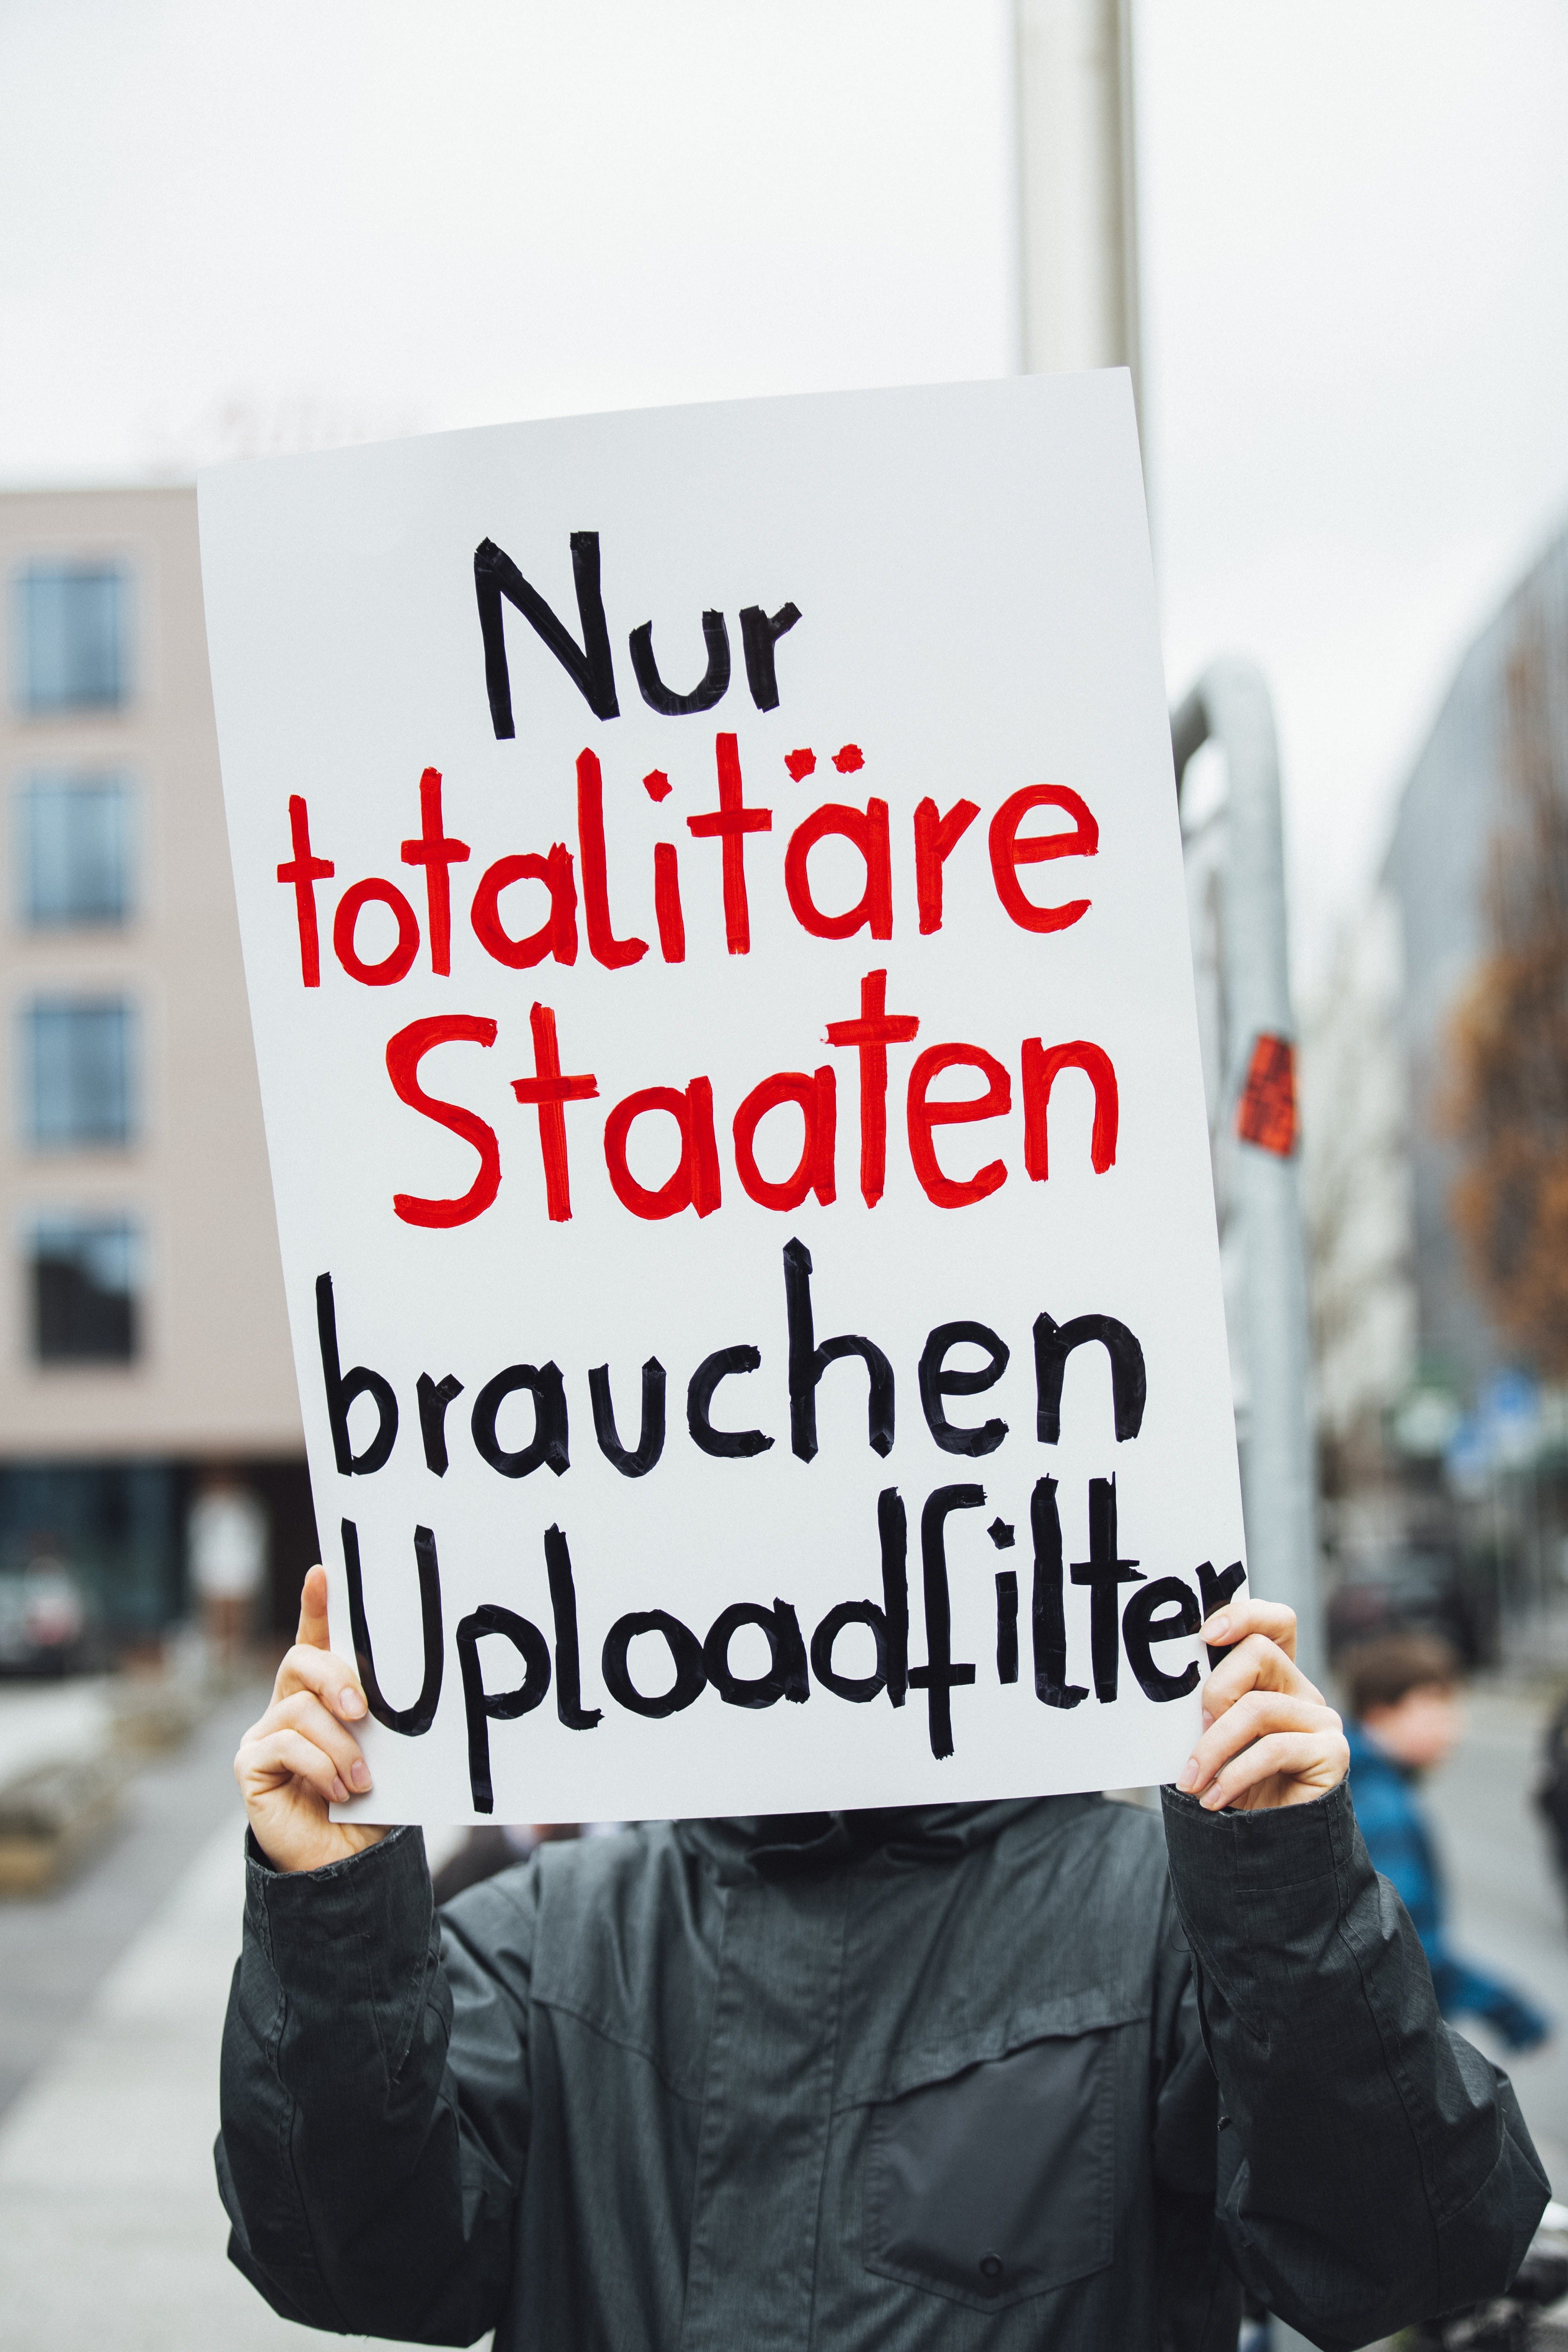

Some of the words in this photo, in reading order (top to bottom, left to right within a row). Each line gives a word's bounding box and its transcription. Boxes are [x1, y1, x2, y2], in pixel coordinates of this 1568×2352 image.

[474, 531, 802, 740] Nur
[277, 733, 1099, 987] totalitäre
[386, 969, 1118, 1228] Staaten
[316, 1237, 1146, 1477] brauchen
[341, 1471, 1246, 1814] Uploadfilter
